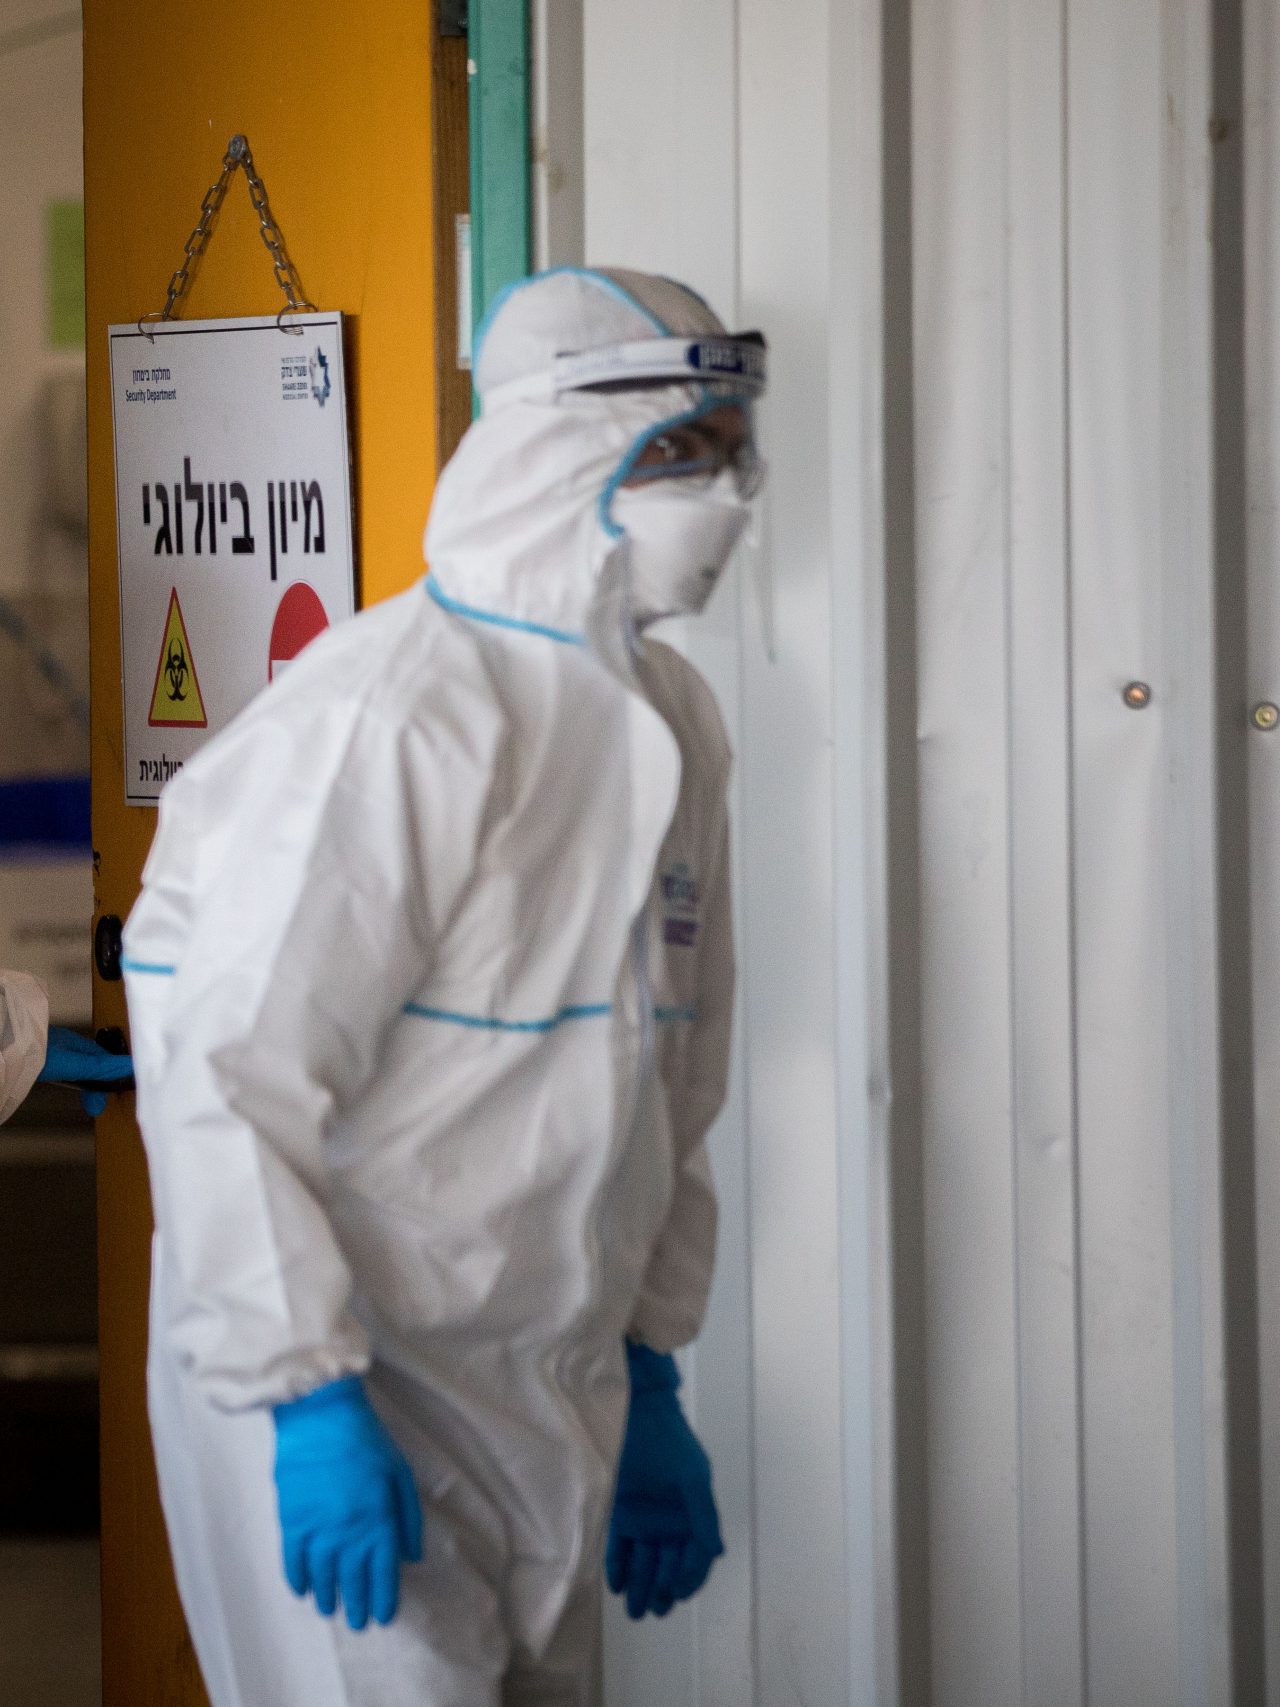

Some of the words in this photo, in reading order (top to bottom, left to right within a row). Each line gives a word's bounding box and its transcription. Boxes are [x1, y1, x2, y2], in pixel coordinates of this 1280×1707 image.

[125, 389, 147, 404] Security
[146, 388, 177, 404] Department
[142, 455, 255, 555] ביולוגי
[267, 478, 326, 581] מיון
